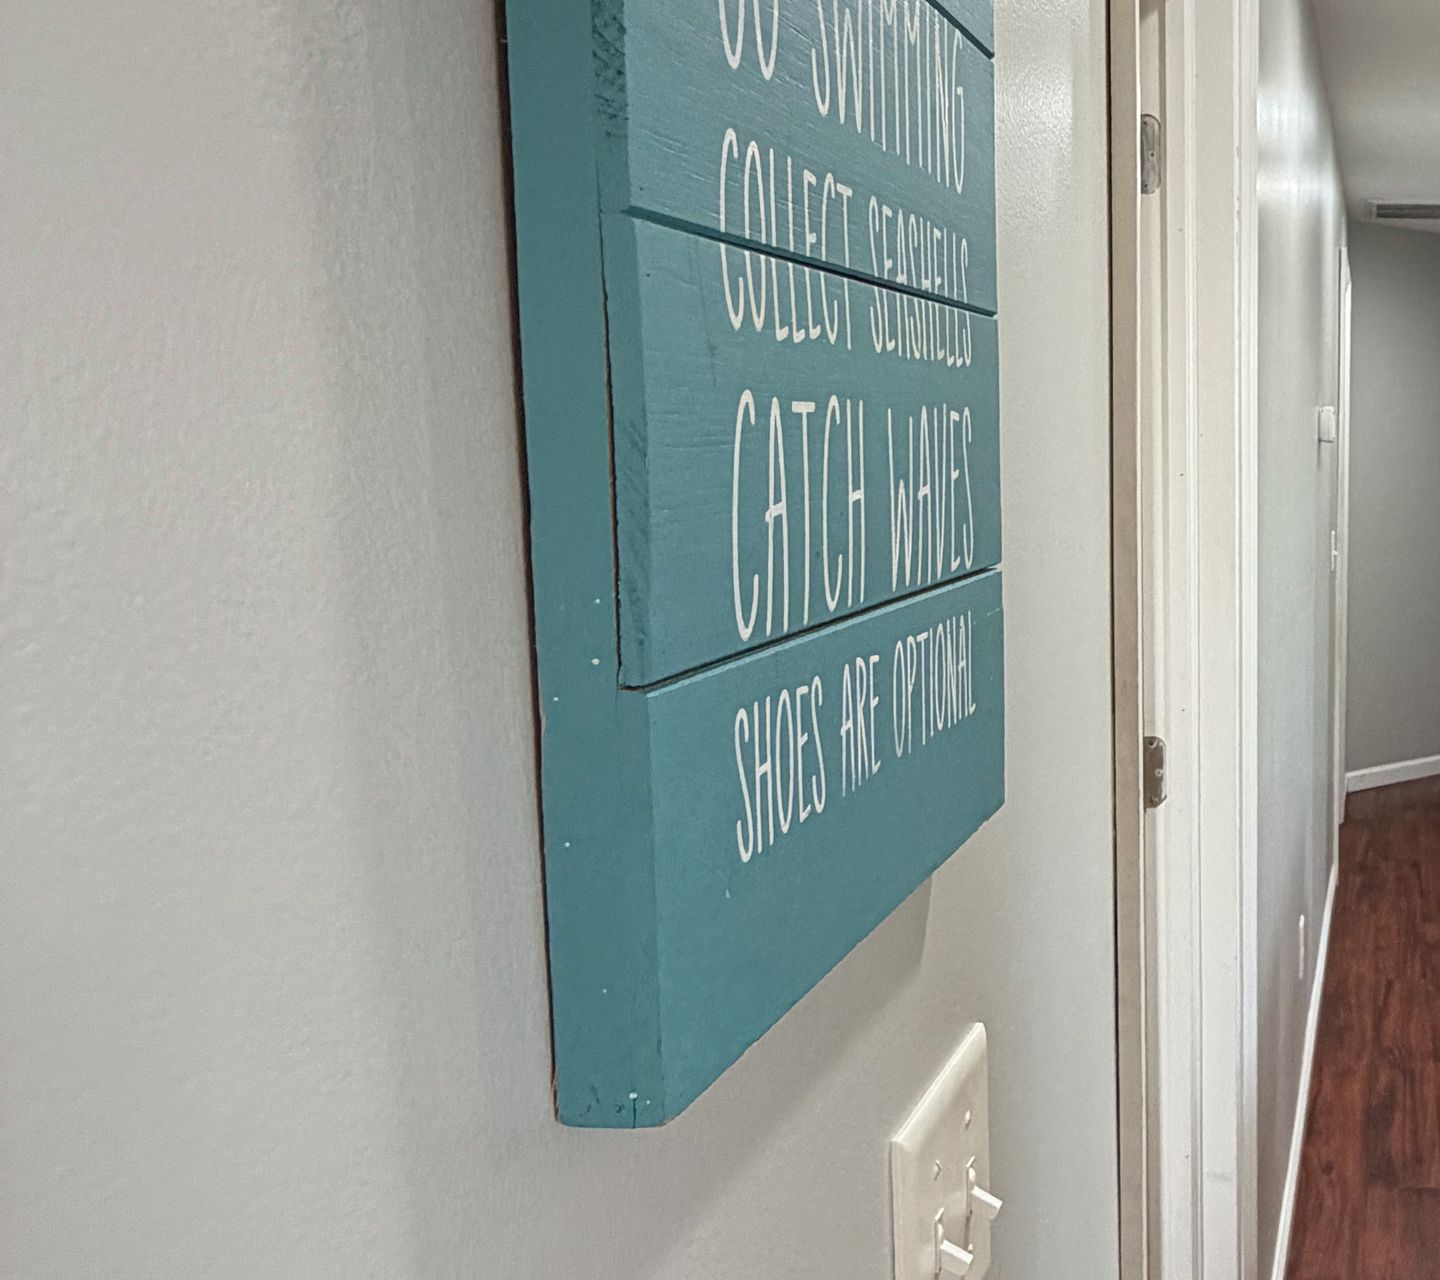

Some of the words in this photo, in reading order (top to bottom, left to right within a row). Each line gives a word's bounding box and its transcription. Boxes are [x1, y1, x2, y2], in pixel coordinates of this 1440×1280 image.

[719, 127, 853, 352] COLLECT
[869, 191, 972, 369] SEASHELLS
[732, 388, 864, 642] CATCH
[887, 405, 974, 593] WAVES
[734, 674, 828, 864] SHOES
[841, 653, 882, 798] ARE
[892, 608, 976, 761] OPTIONAL
